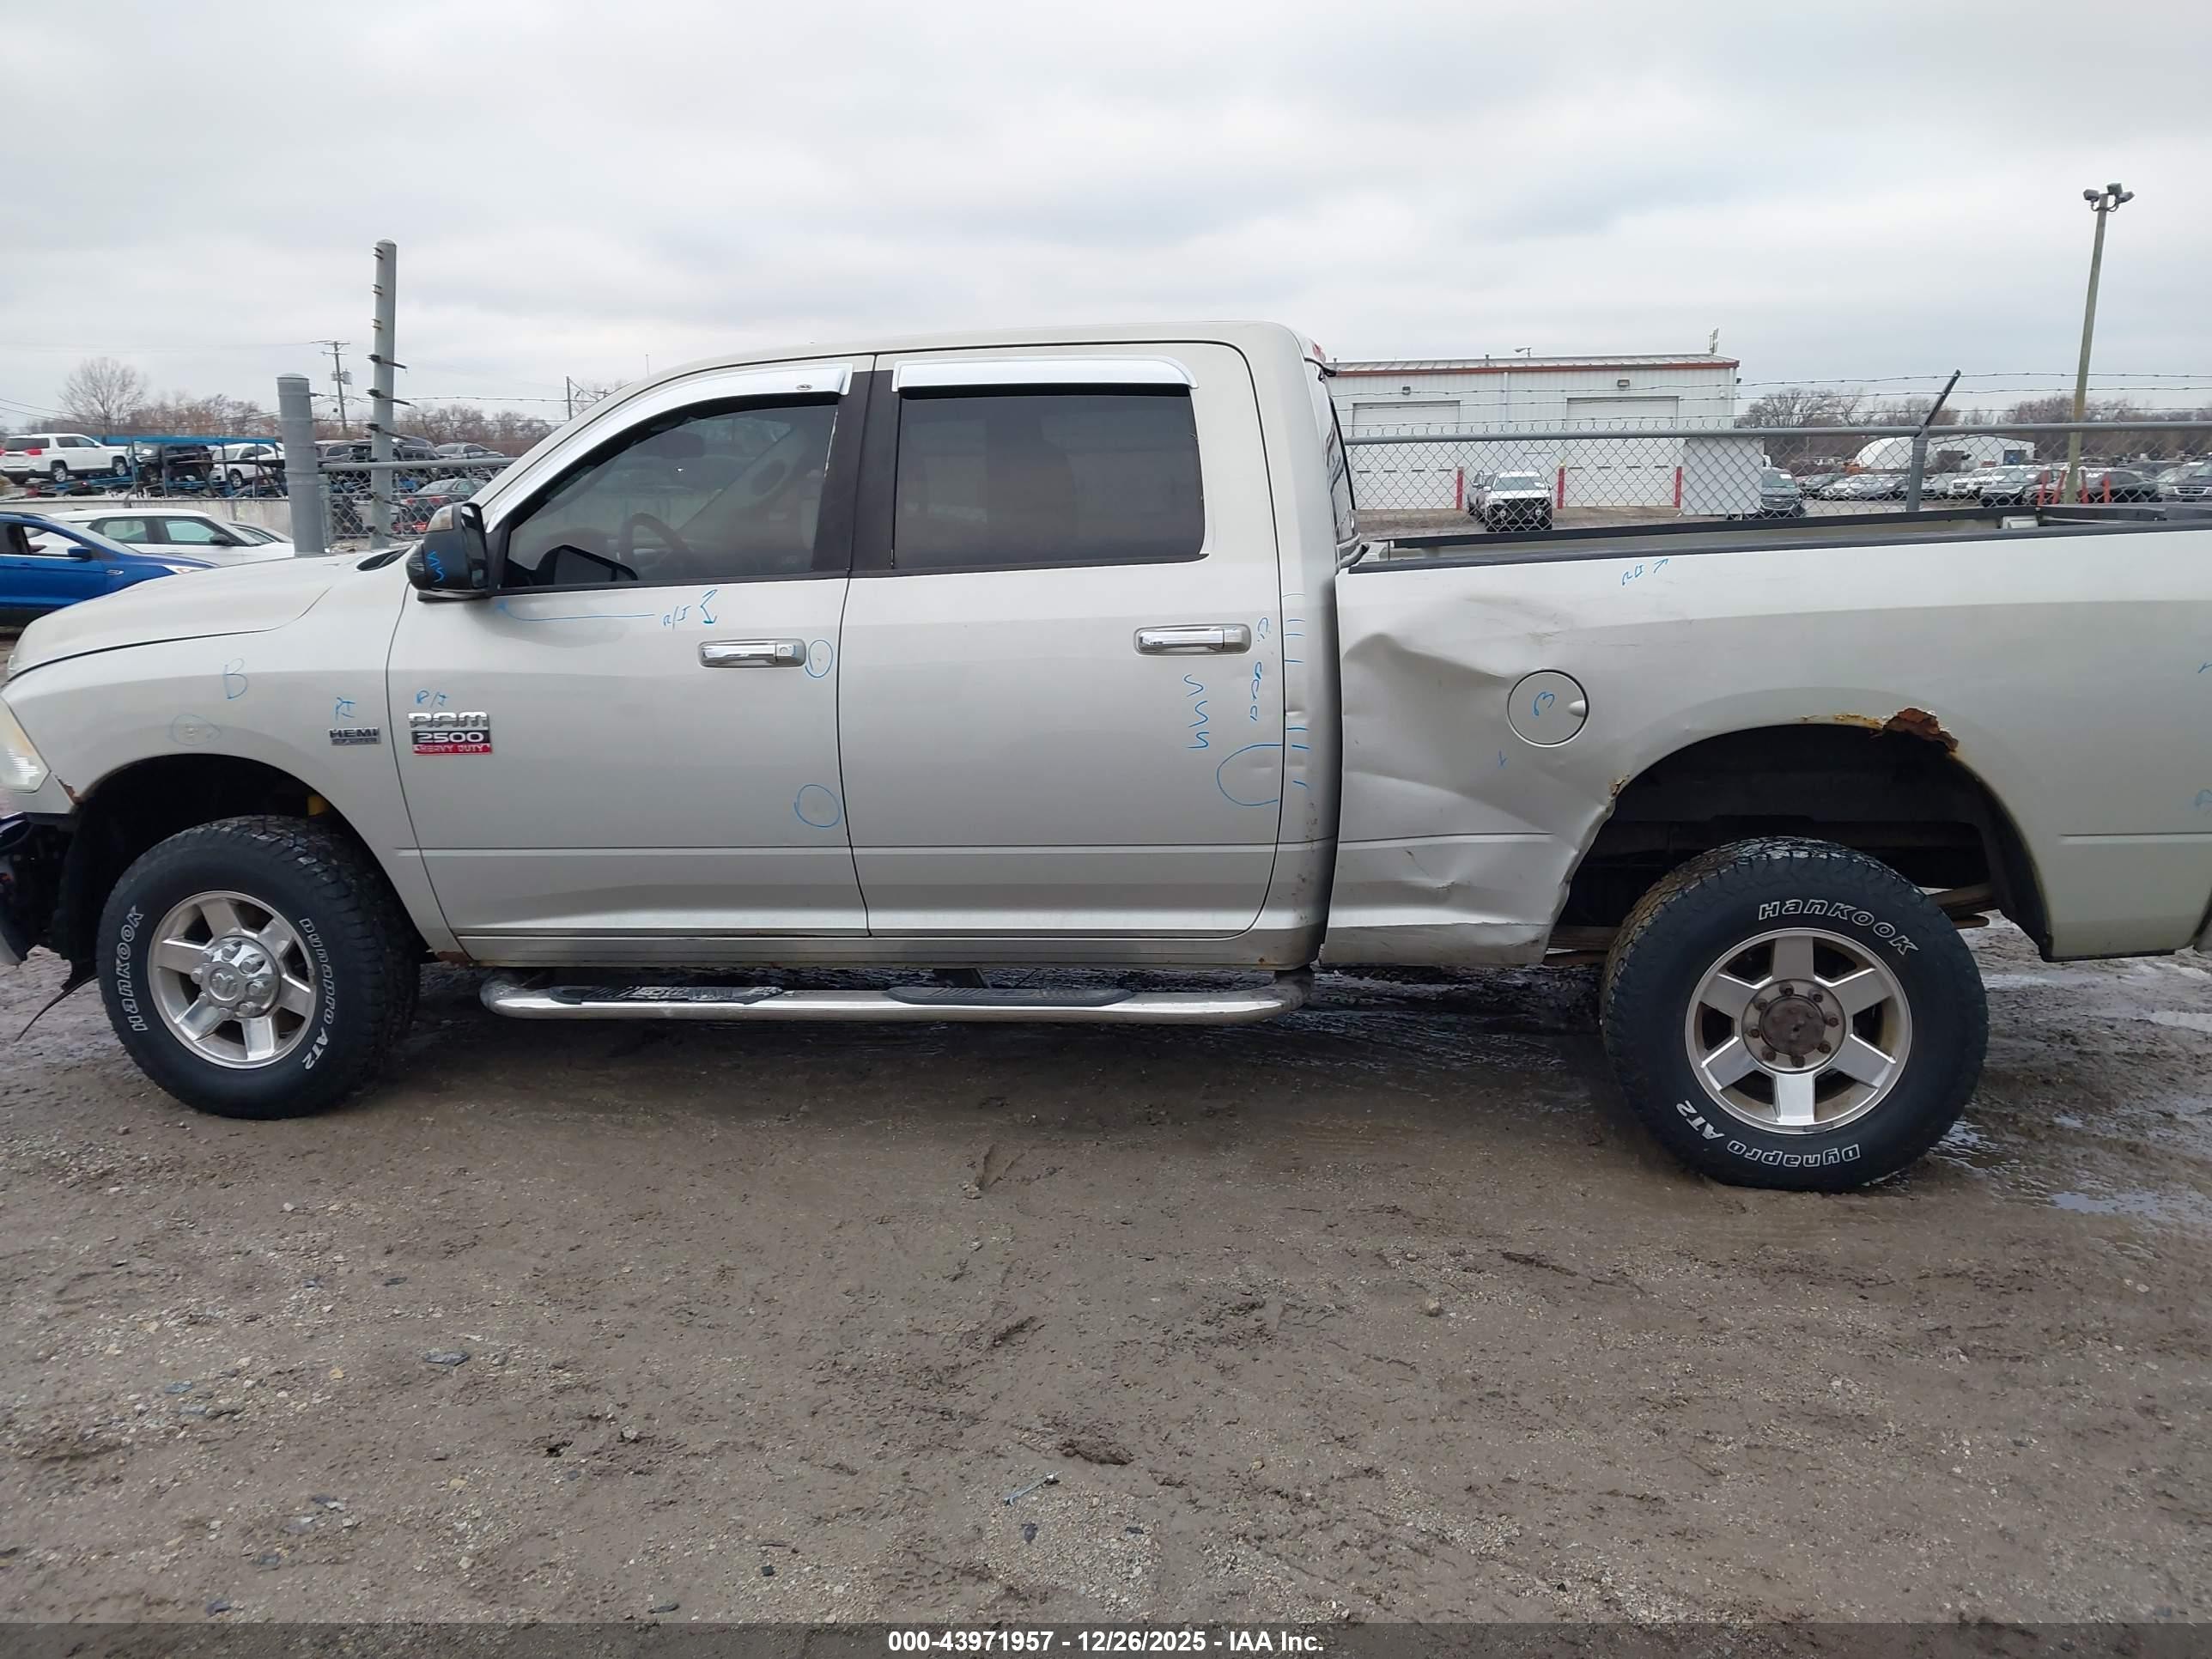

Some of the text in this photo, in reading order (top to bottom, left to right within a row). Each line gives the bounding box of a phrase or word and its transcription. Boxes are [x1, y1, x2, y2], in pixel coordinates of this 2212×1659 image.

[408, 711, 489, 728] RAM
[329, 727, 380, 739] HEMI
[416, 732, 484, 744] 2500
[457, 744, 484, 752] DUTY
[301, 1027, 330, 1070] AT2
[1675, 1099, 1862, 1168] Dynapro AT2
